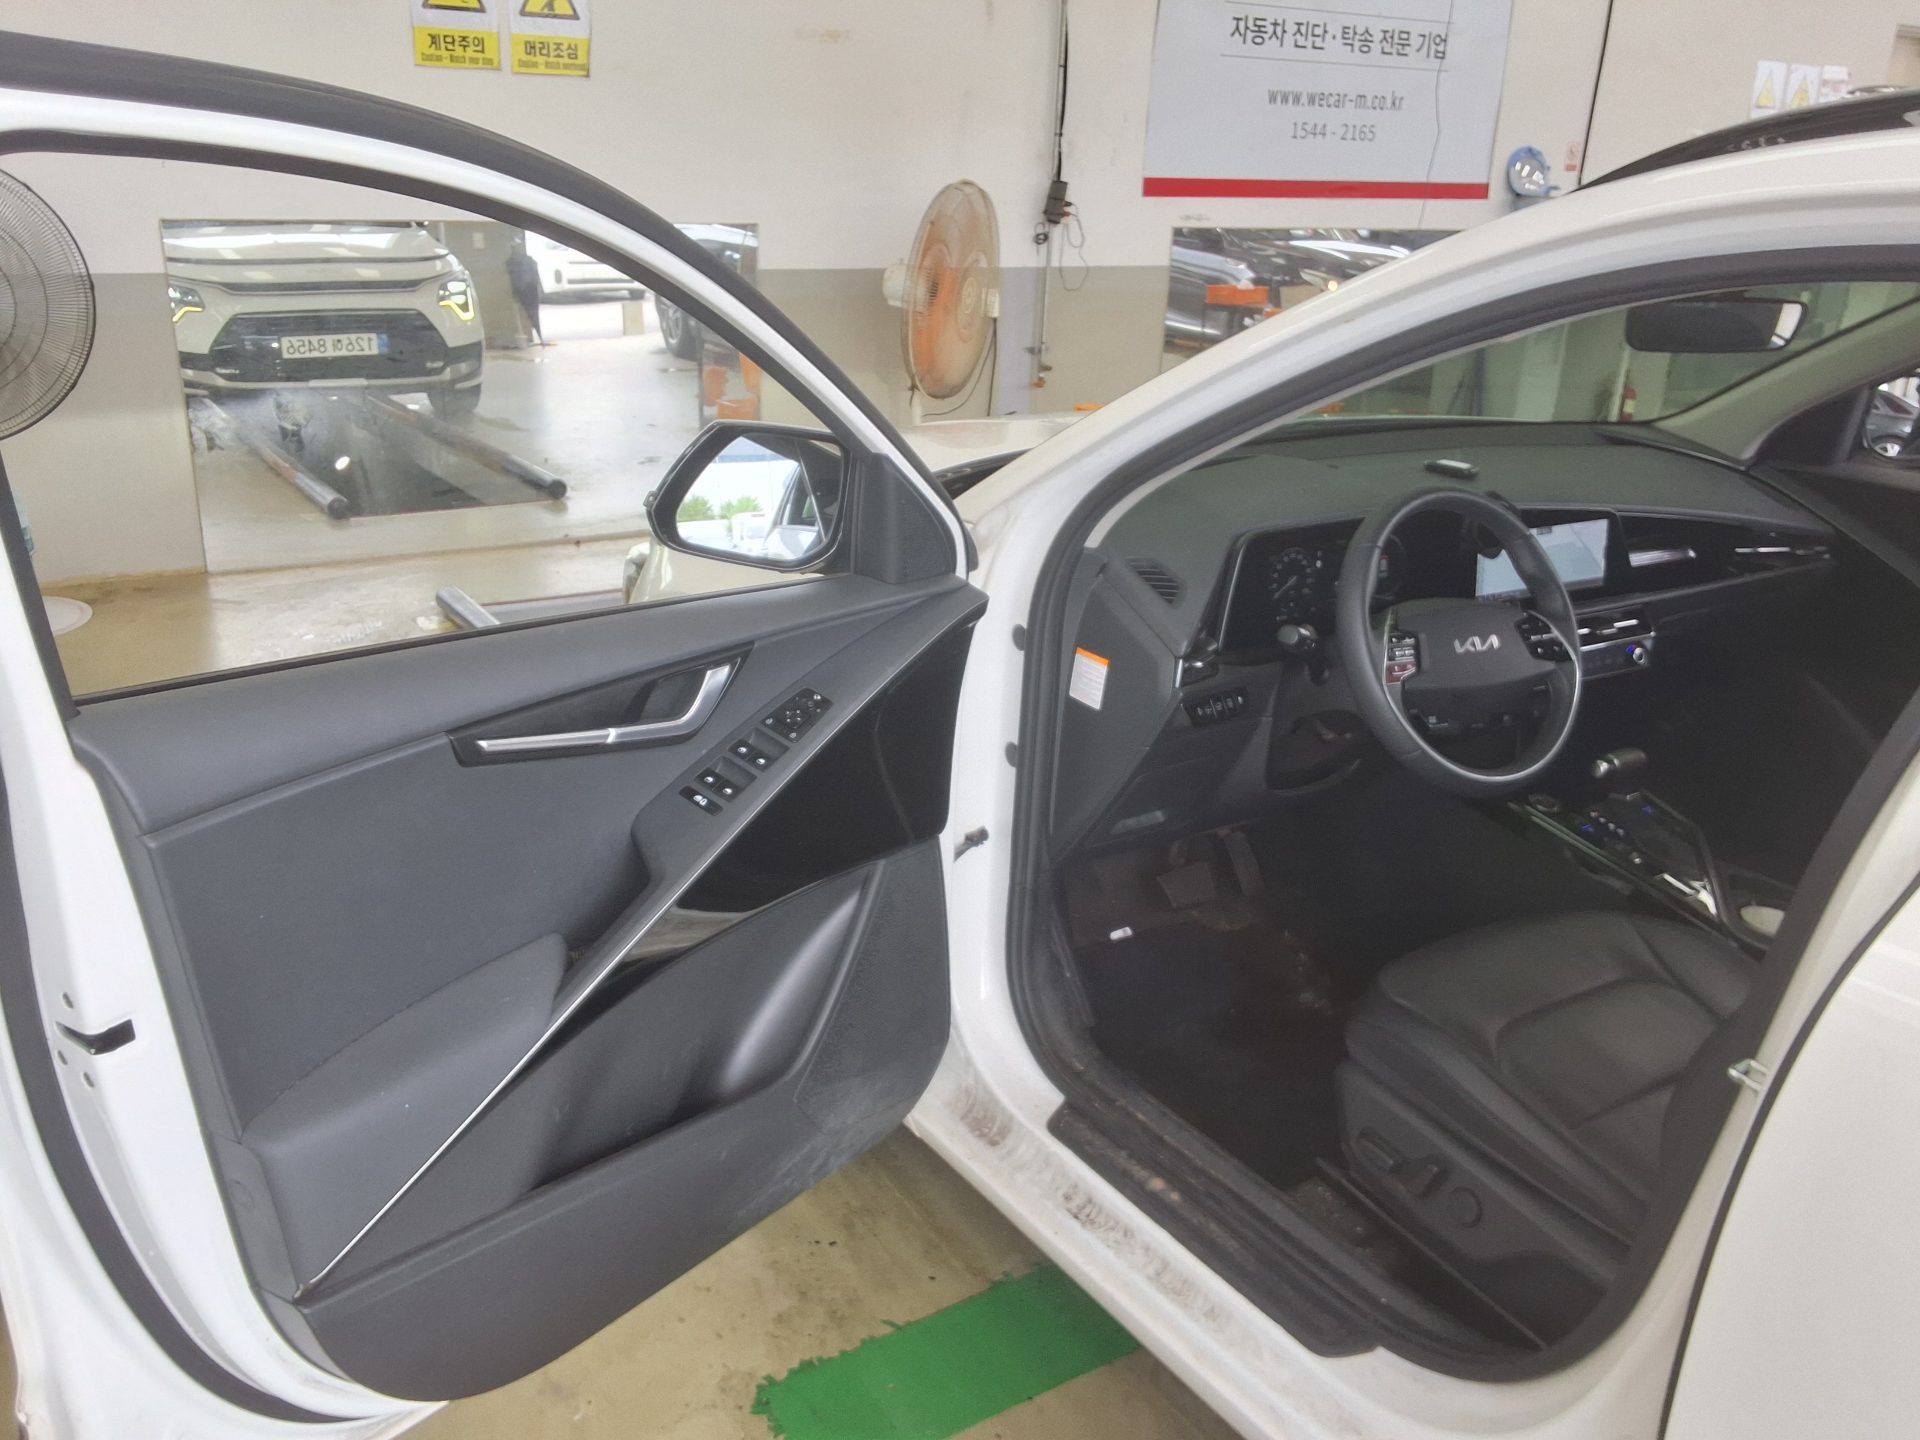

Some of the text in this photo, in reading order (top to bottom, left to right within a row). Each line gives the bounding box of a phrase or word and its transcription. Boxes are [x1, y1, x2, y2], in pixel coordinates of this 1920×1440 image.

[427, 33, 485, 54] 계단주의
[1230, 15, 1287, 48] 자동차
[1379, 29, 1412, 57] 전문
[1415, 32, 1448, 60] 기업
[524, 40, 578, 60] 머리조심
[1267, 88, 1404, 112] www.wecar-m.co.kr
[1453, 633, 1500, 653] KIA
